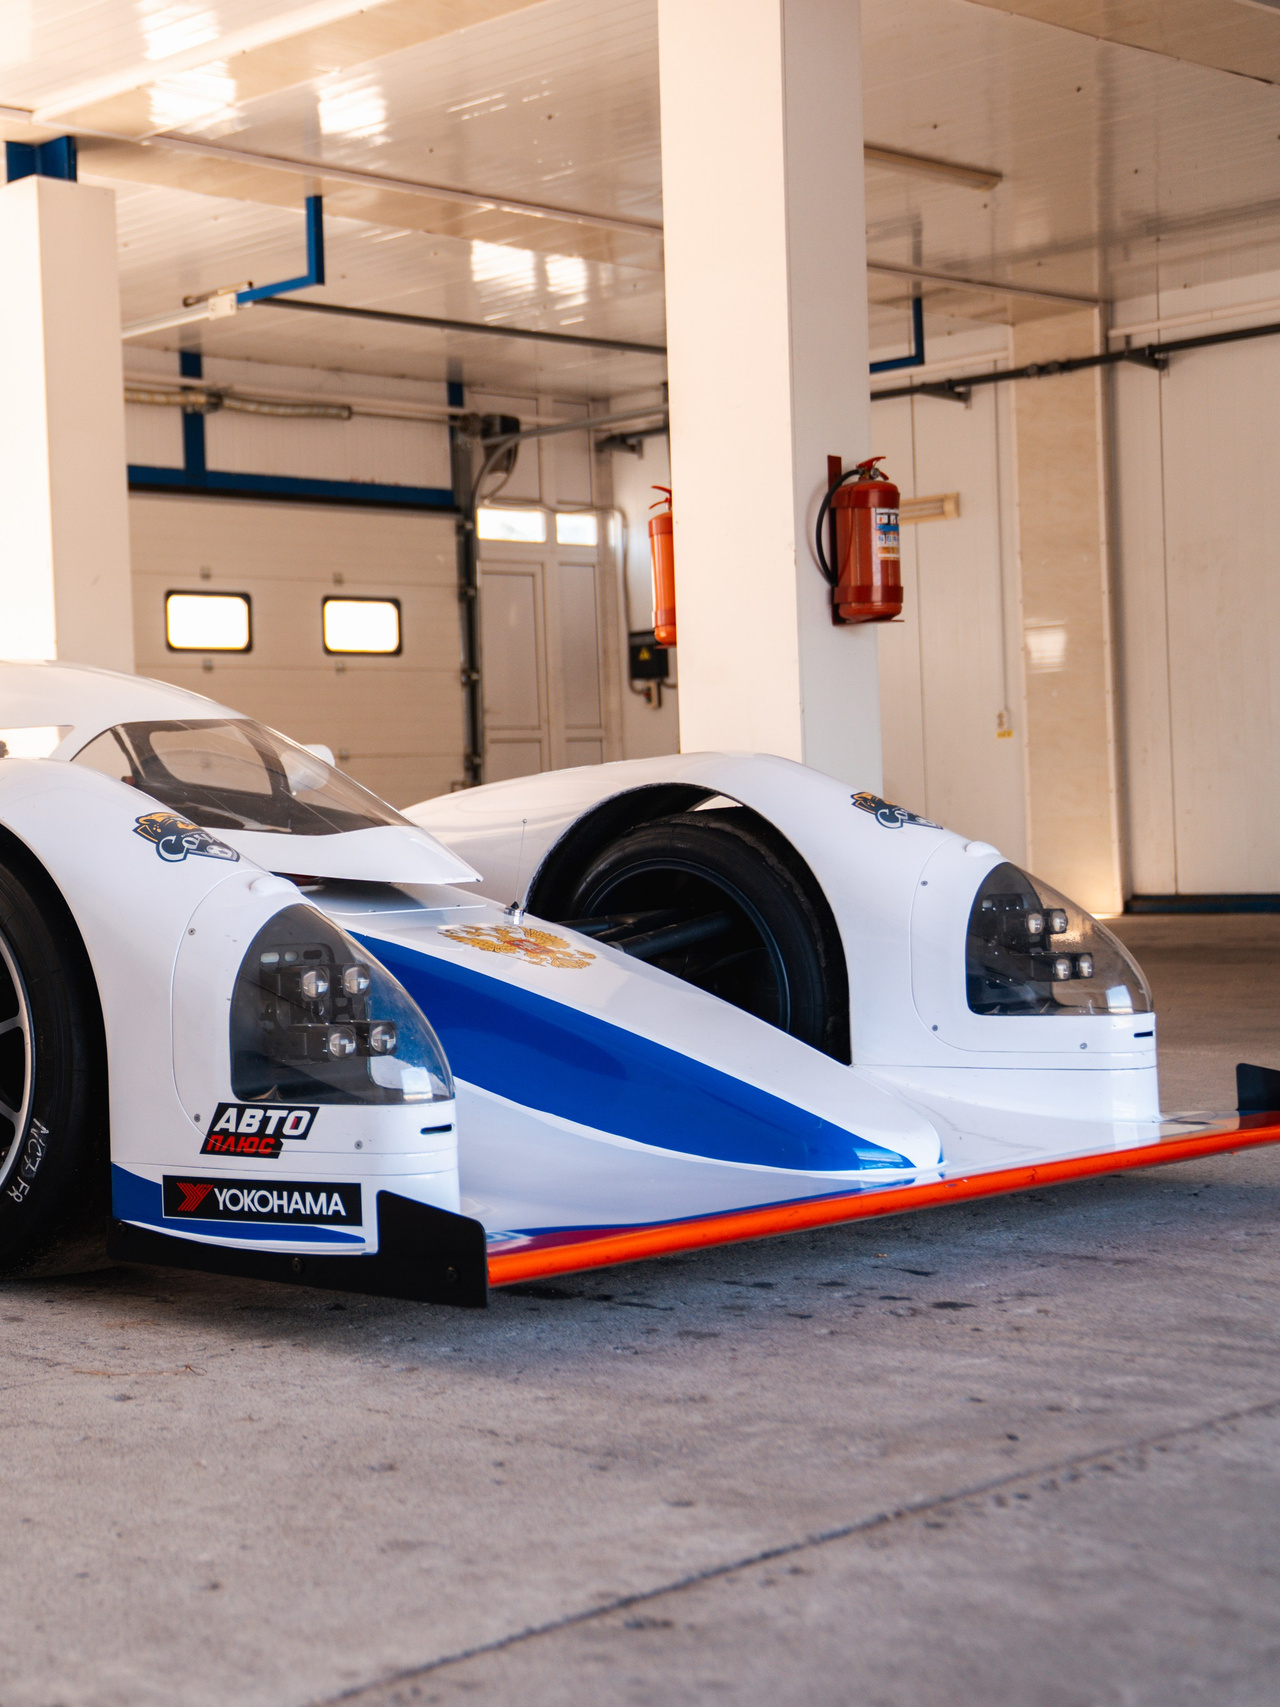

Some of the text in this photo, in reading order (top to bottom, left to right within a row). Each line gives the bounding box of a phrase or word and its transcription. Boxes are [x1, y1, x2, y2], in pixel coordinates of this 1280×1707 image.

[212, 1107, 312, 1136] АВТО
[205, 1134, 276, 1155] ПЛЮС
[213, 1188, 347, 1217] YOKOHAMA
